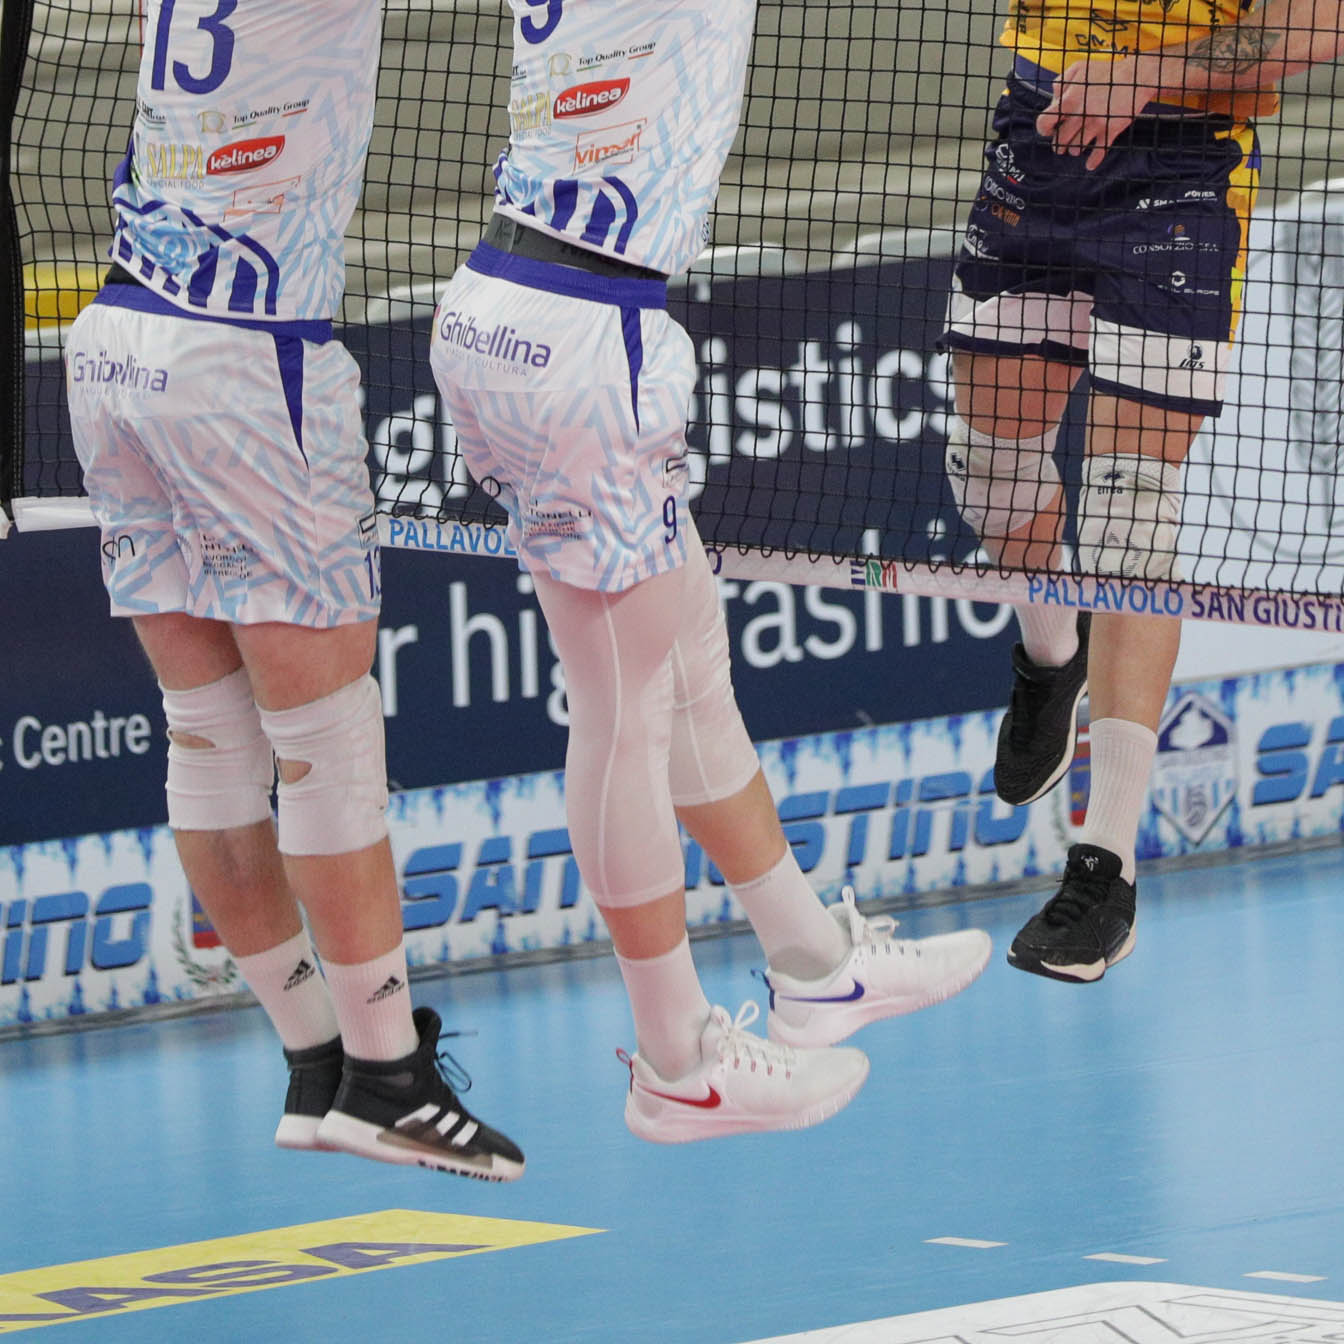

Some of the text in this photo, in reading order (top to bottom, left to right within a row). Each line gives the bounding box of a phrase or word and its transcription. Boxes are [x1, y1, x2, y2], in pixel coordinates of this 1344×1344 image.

[556, 87, 622, 114] kèlinea
[210, 145, 278, 171] kèlinea
[440, 311, 552, 369] Ghibellina
[388, 517, 519, 556] PALLAVOL
[662, 494, 678, 545] 9
[1027, 576, 1184, 617] PALLAVOLO
[1190, 590, 1247, 623] SAN
[13, 711, 152, 769] Centre
